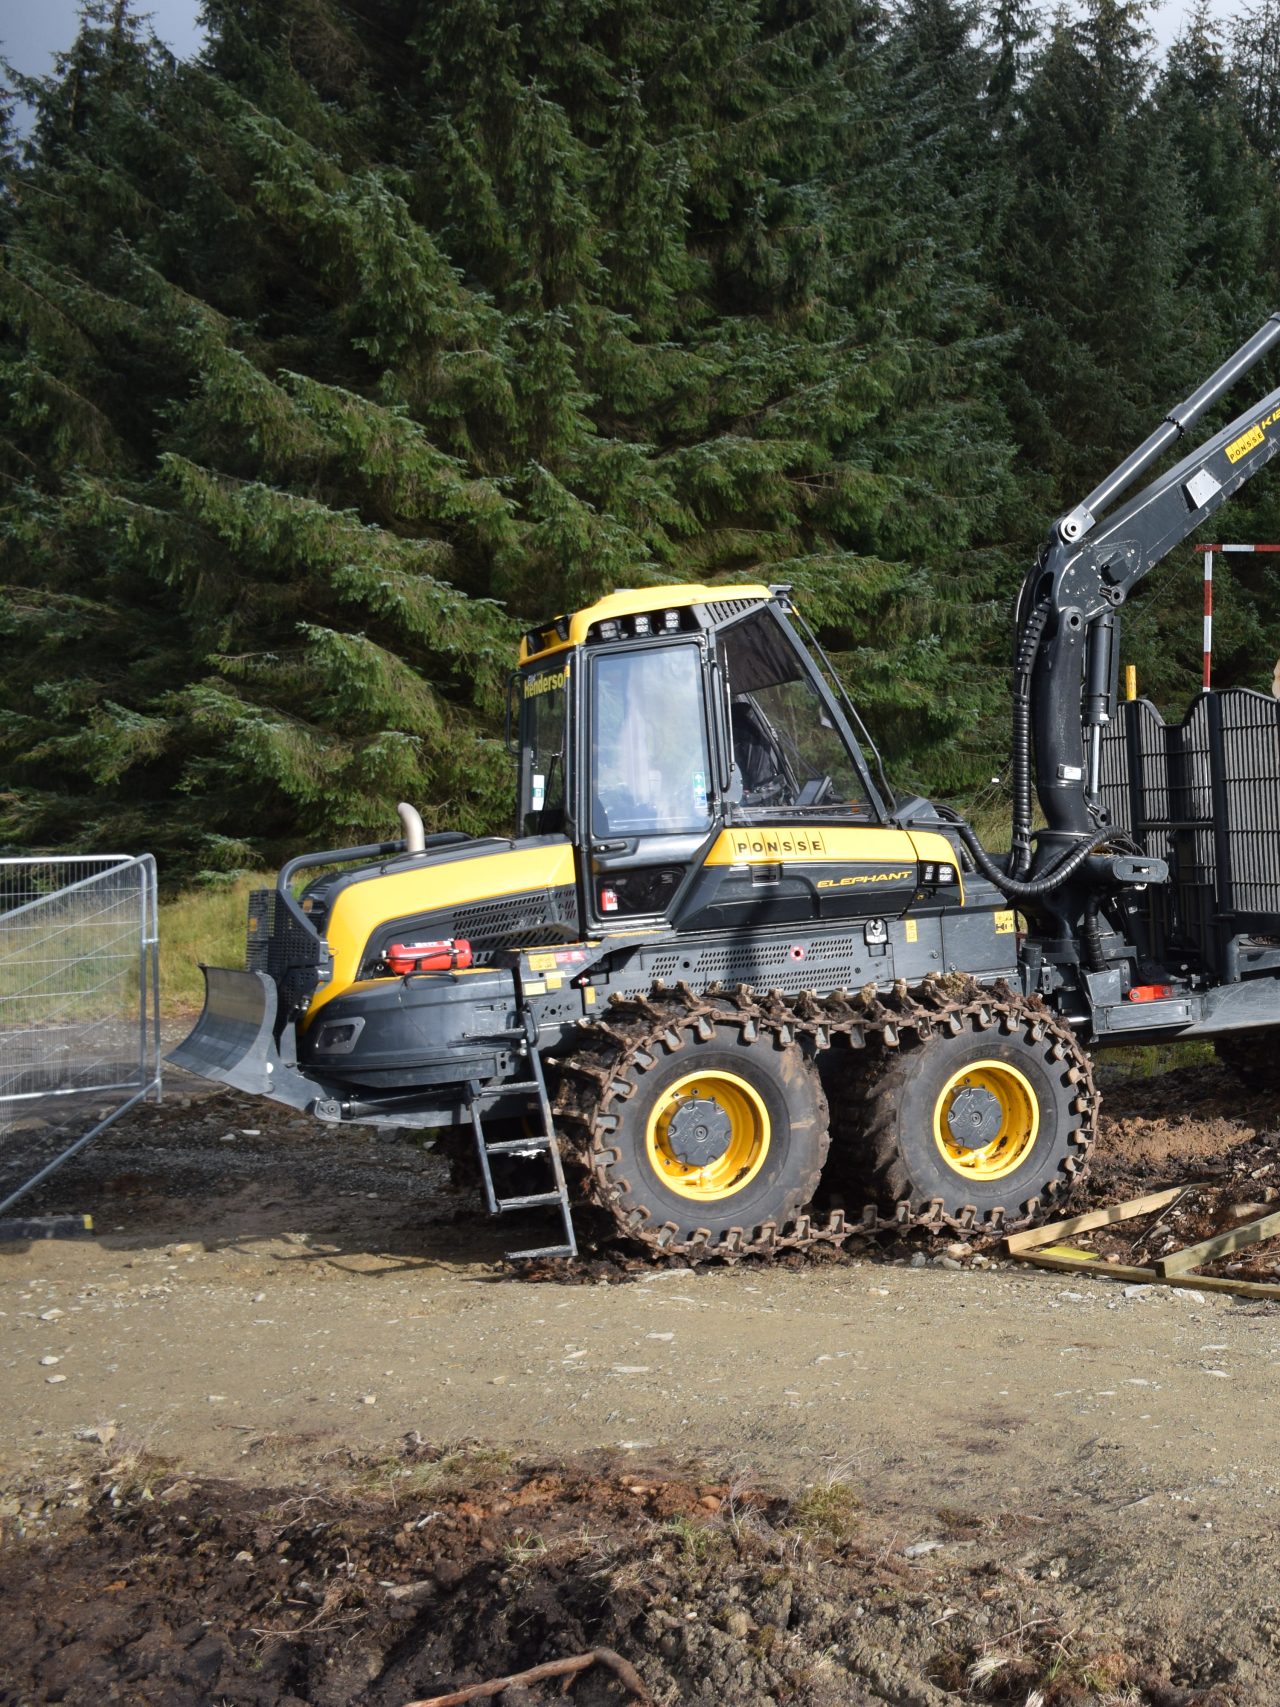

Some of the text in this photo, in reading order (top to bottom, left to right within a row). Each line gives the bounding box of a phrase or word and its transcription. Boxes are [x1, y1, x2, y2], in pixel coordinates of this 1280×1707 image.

[1229, 432, 1263, 460] PONSSE
[737, 840, 822, 853] PONSSE
[817, 870, 912, 888] ELEPHANT
